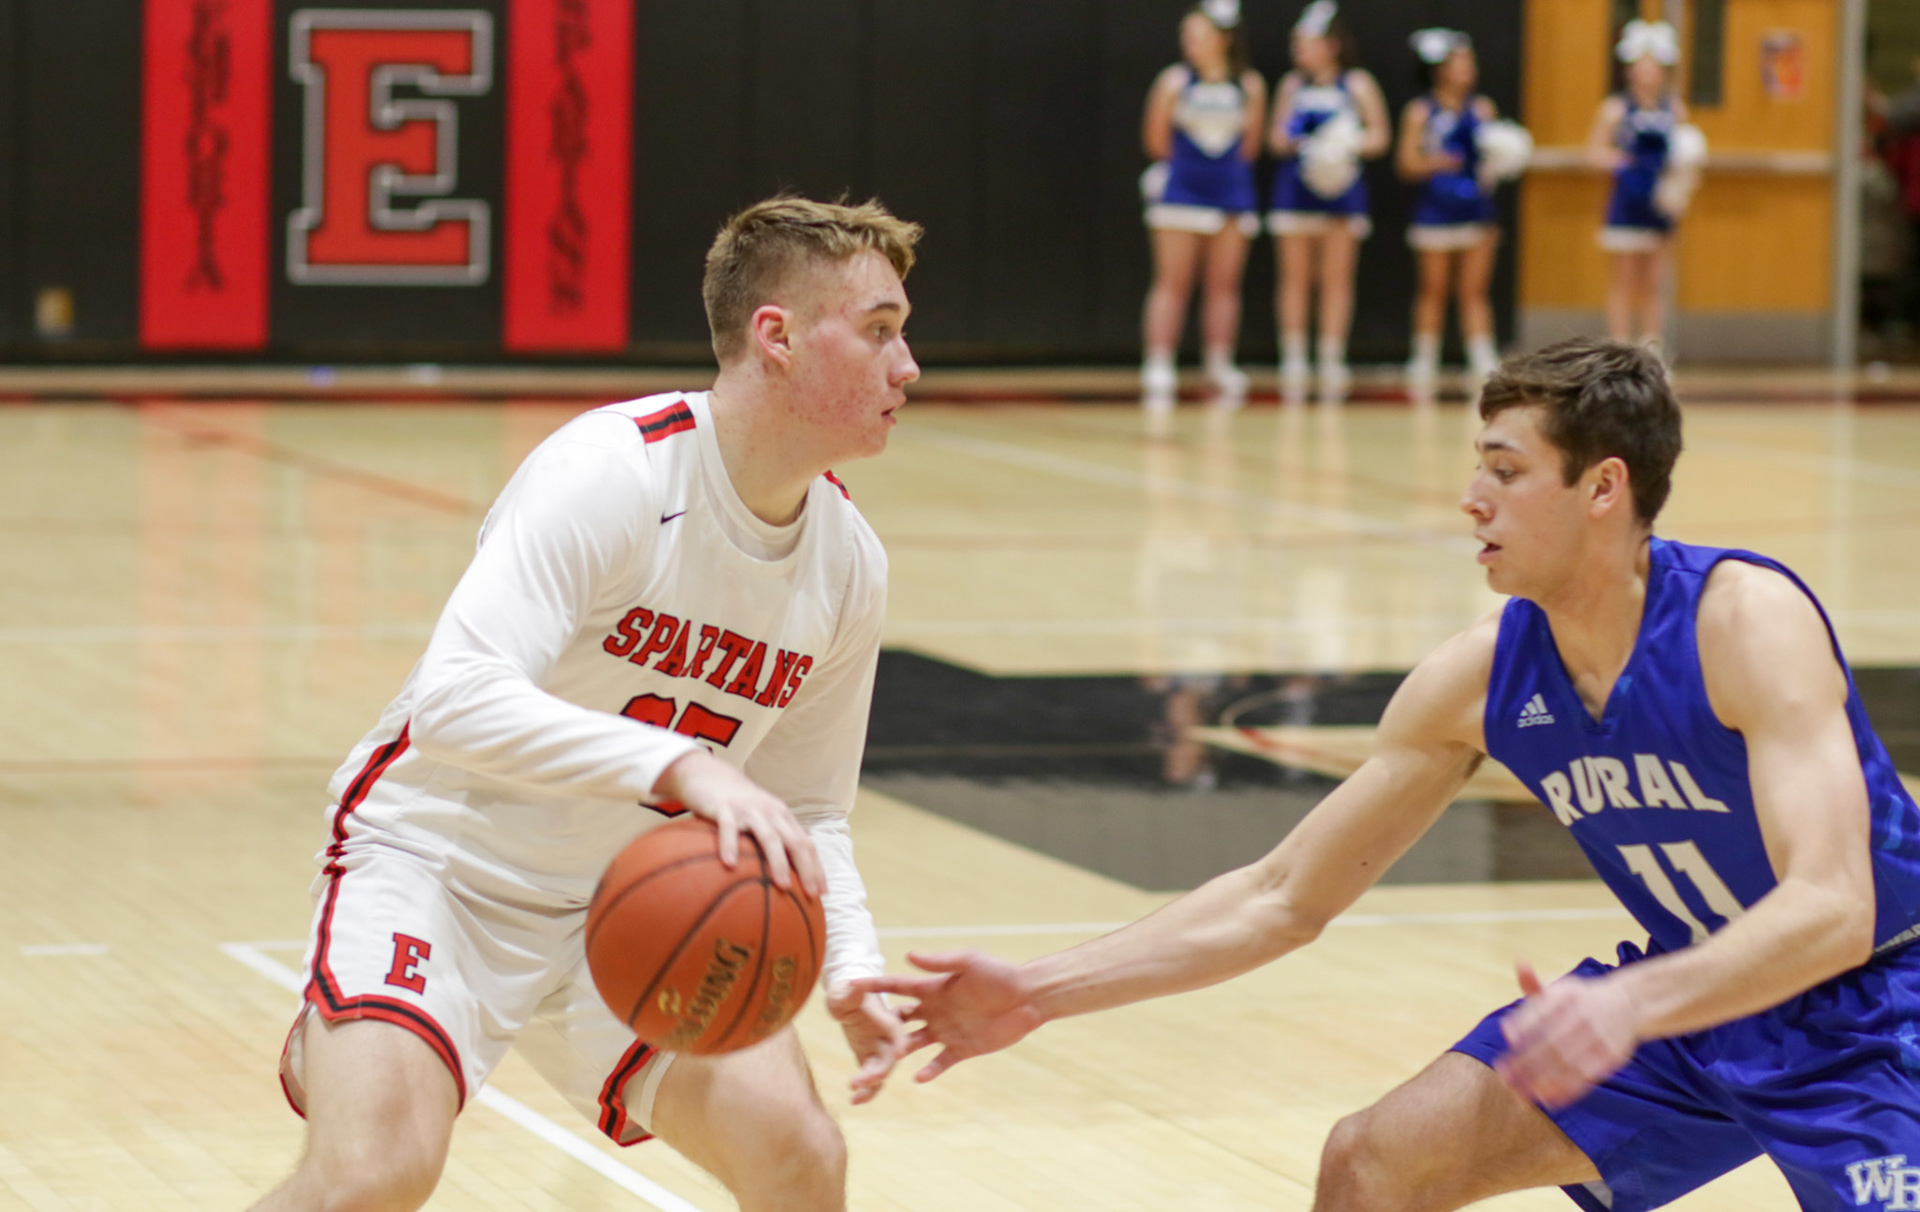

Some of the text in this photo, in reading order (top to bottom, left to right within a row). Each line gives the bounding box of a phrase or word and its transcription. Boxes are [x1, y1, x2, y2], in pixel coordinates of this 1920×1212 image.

[288, 8, 493, 286] E
[602, 606, 813, 708] SPARTANS
[1516, 714, 1556, 728] adidas
[1540, 753, 1732, 826] RURAL
[1616, 840, 1747, 945] 11
[384, 932, 431, 996] E
